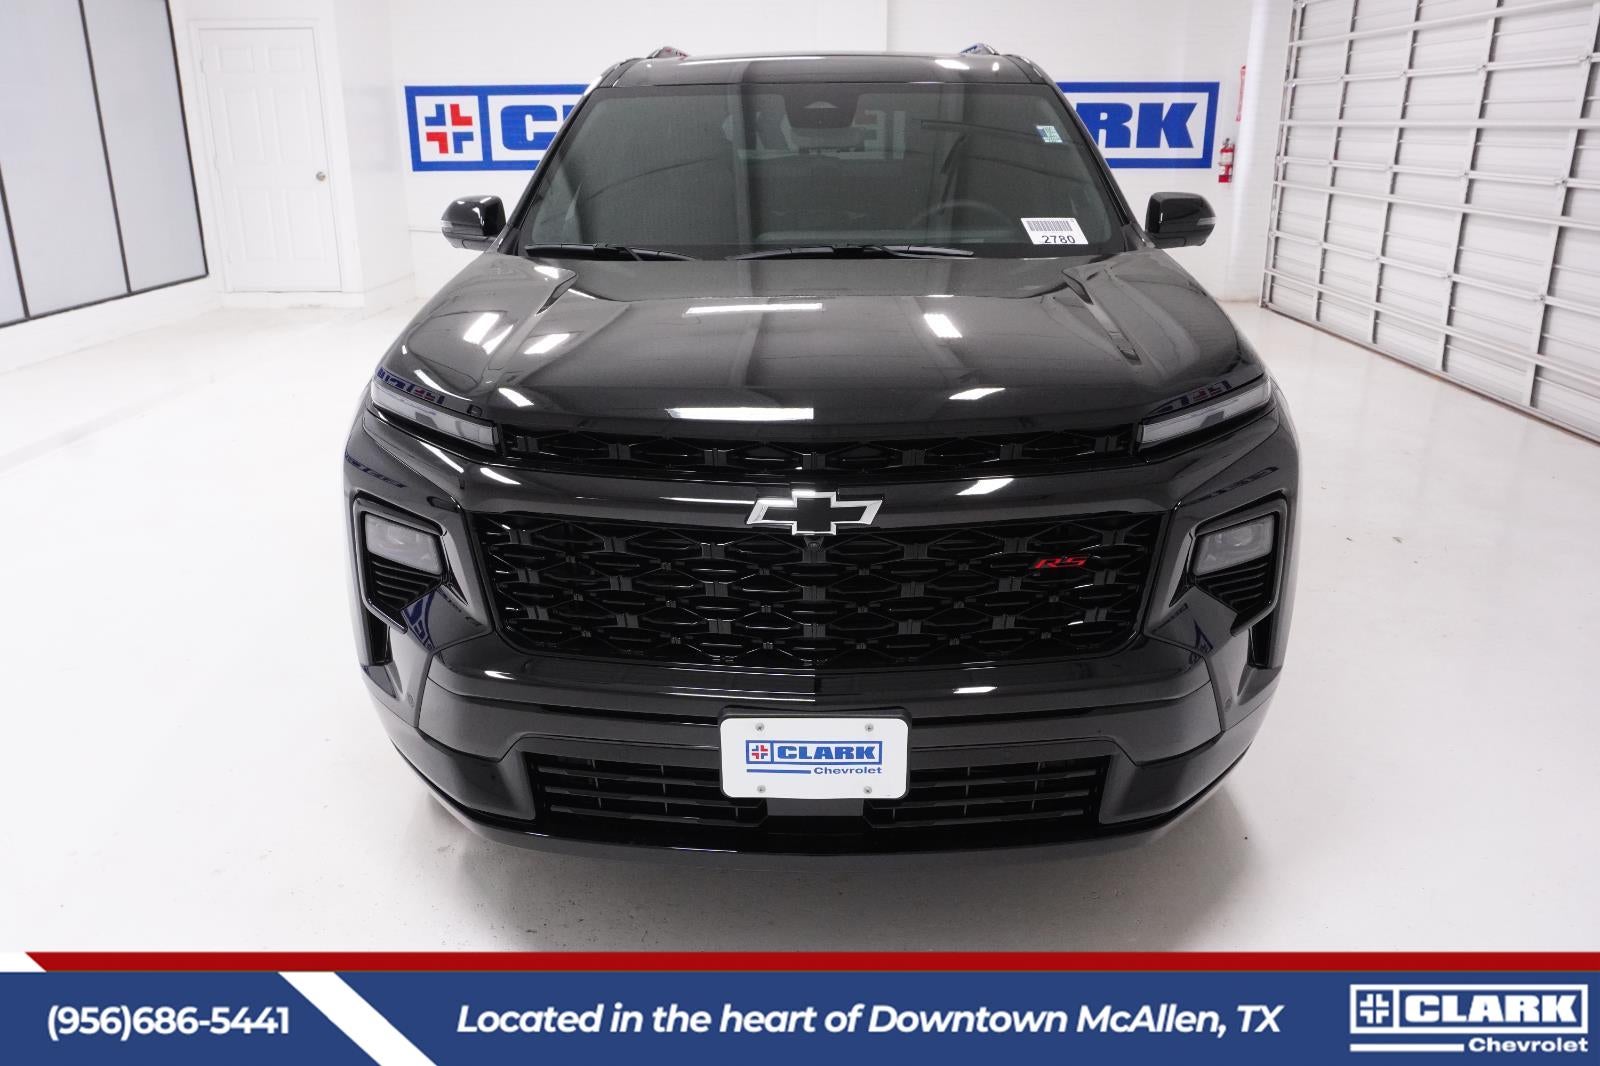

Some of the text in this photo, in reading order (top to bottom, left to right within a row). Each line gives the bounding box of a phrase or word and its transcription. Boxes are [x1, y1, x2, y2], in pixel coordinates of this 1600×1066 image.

[1041, 235, 1076, 244] 2780
[777, 746, 876, 760] CLARK
[813, 766, 883, 775] Chevrolet
